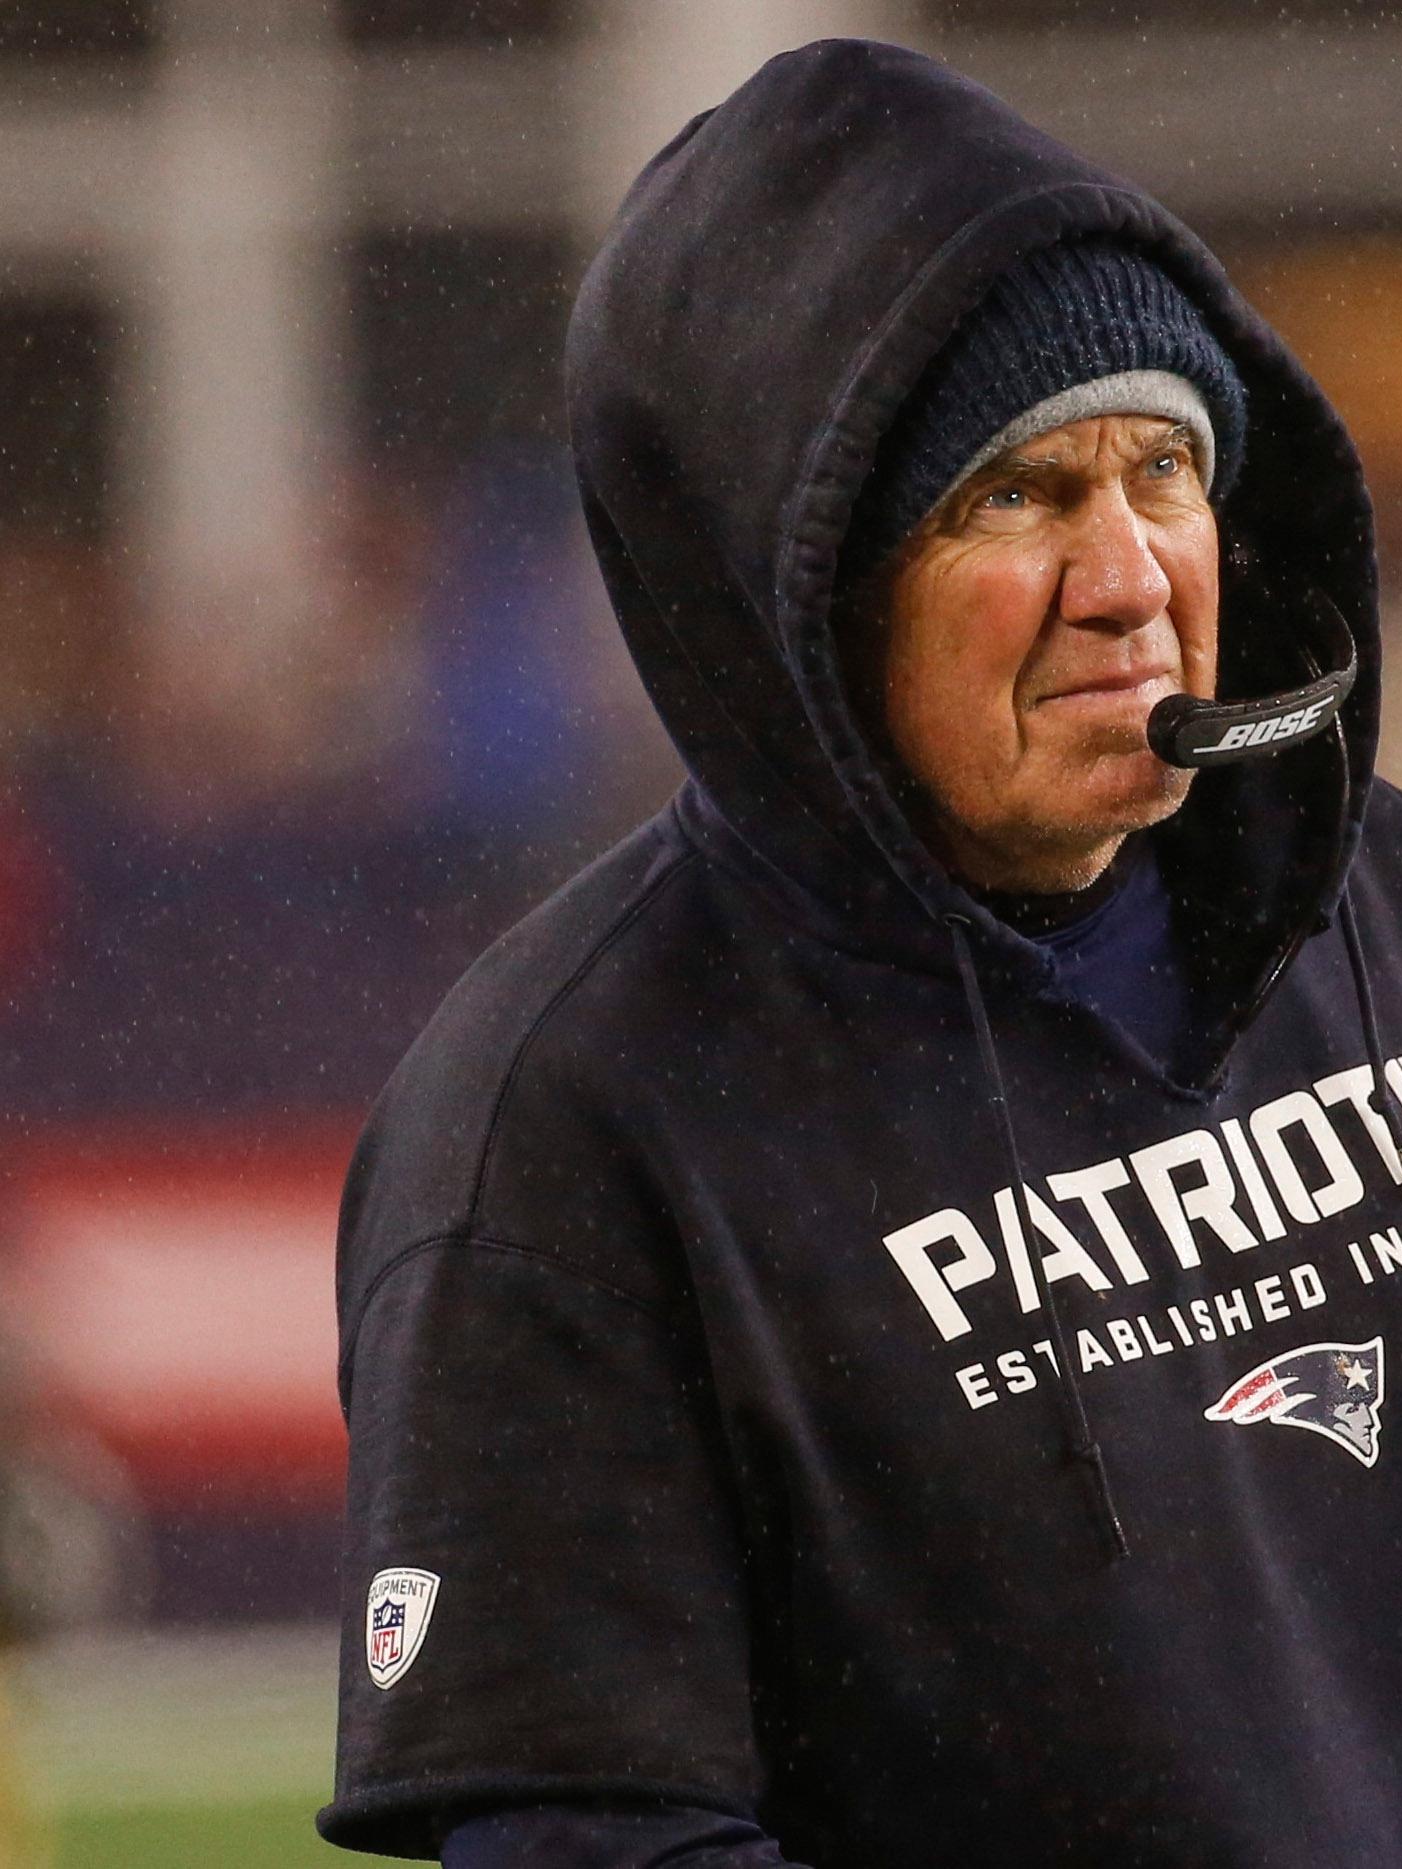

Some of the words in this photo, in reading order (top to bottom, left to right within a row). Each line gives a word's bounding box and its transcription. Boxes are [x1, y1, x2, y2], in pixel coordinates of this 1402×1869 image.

[1193, 695, 1334, 754] BOSE
[955, 1263, 1327, 1410] ESTABLISHED
[371, 1630, 399, 1664] NFL
